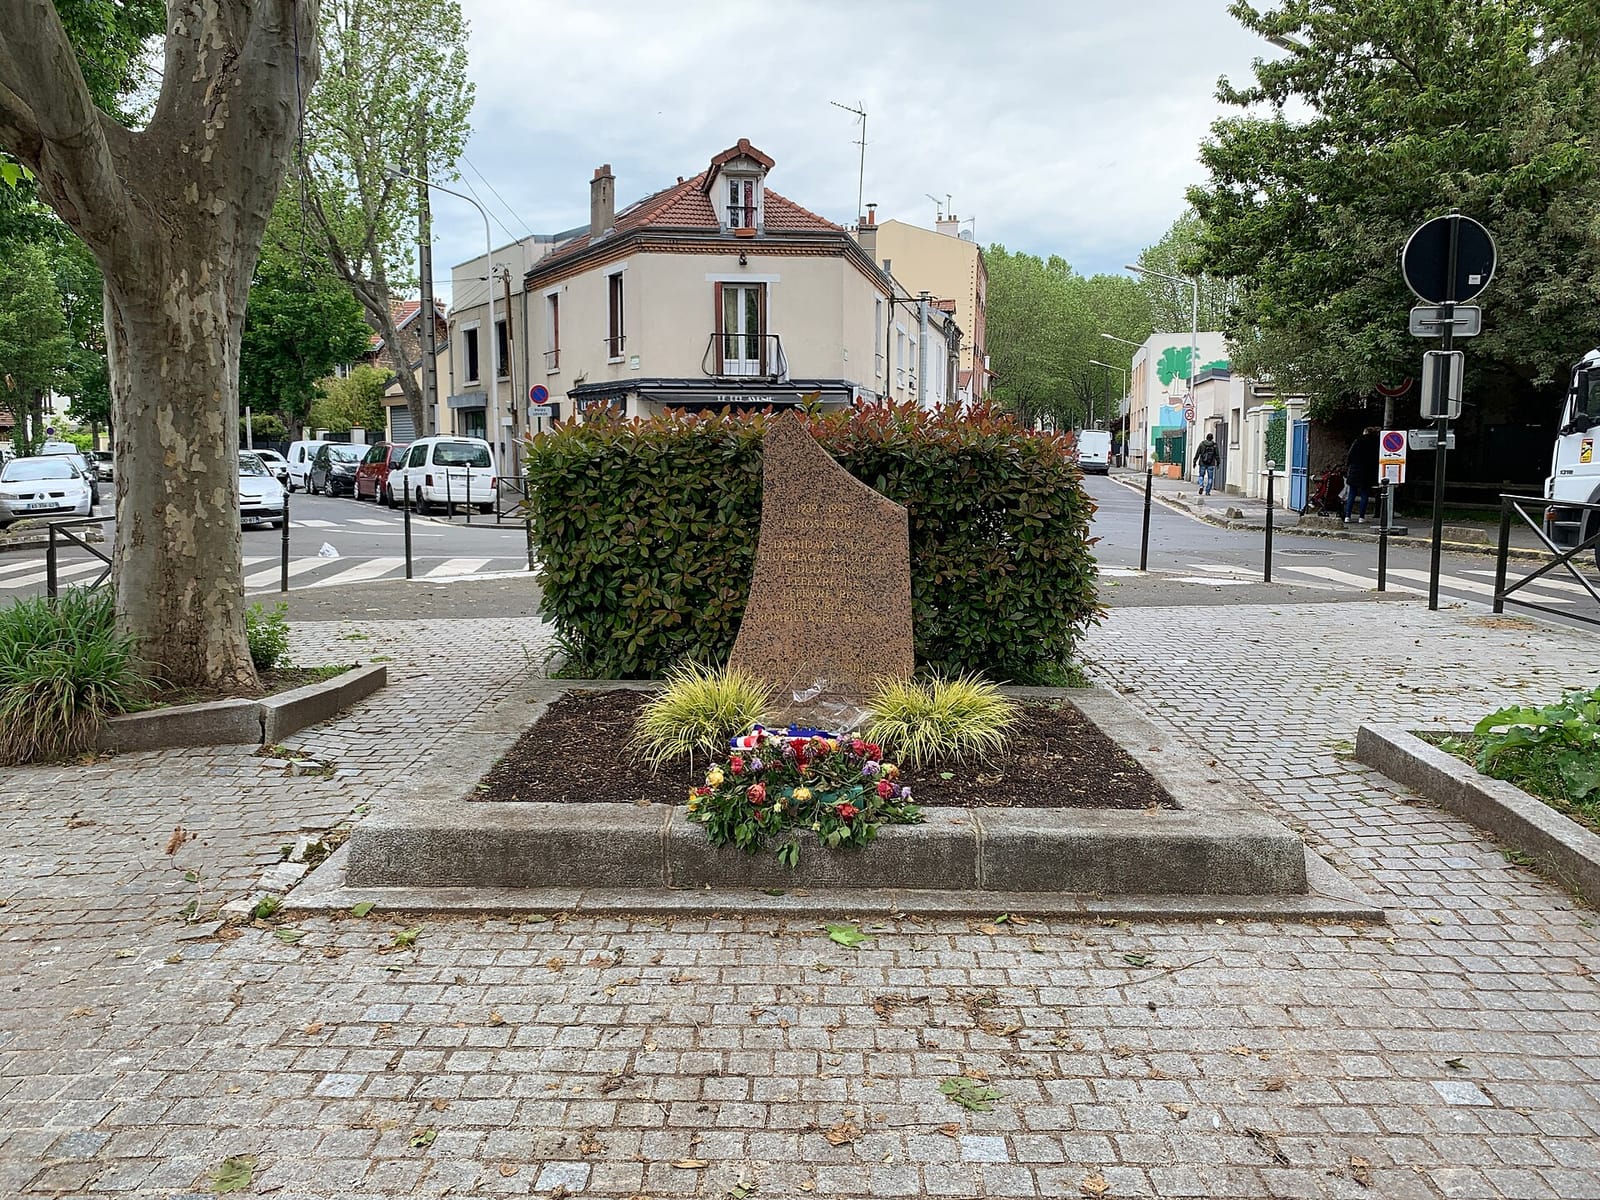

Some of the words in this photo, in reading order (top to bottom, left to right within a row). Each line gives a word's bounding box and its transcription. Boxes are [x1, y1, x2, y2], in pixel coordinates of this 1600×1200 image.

[797, 504, 818, 513] 1939
[828, 504, 851, 513] 1945
[796, 519, 820, 529] NOS
[825, 520, 865, 529] MORTS
